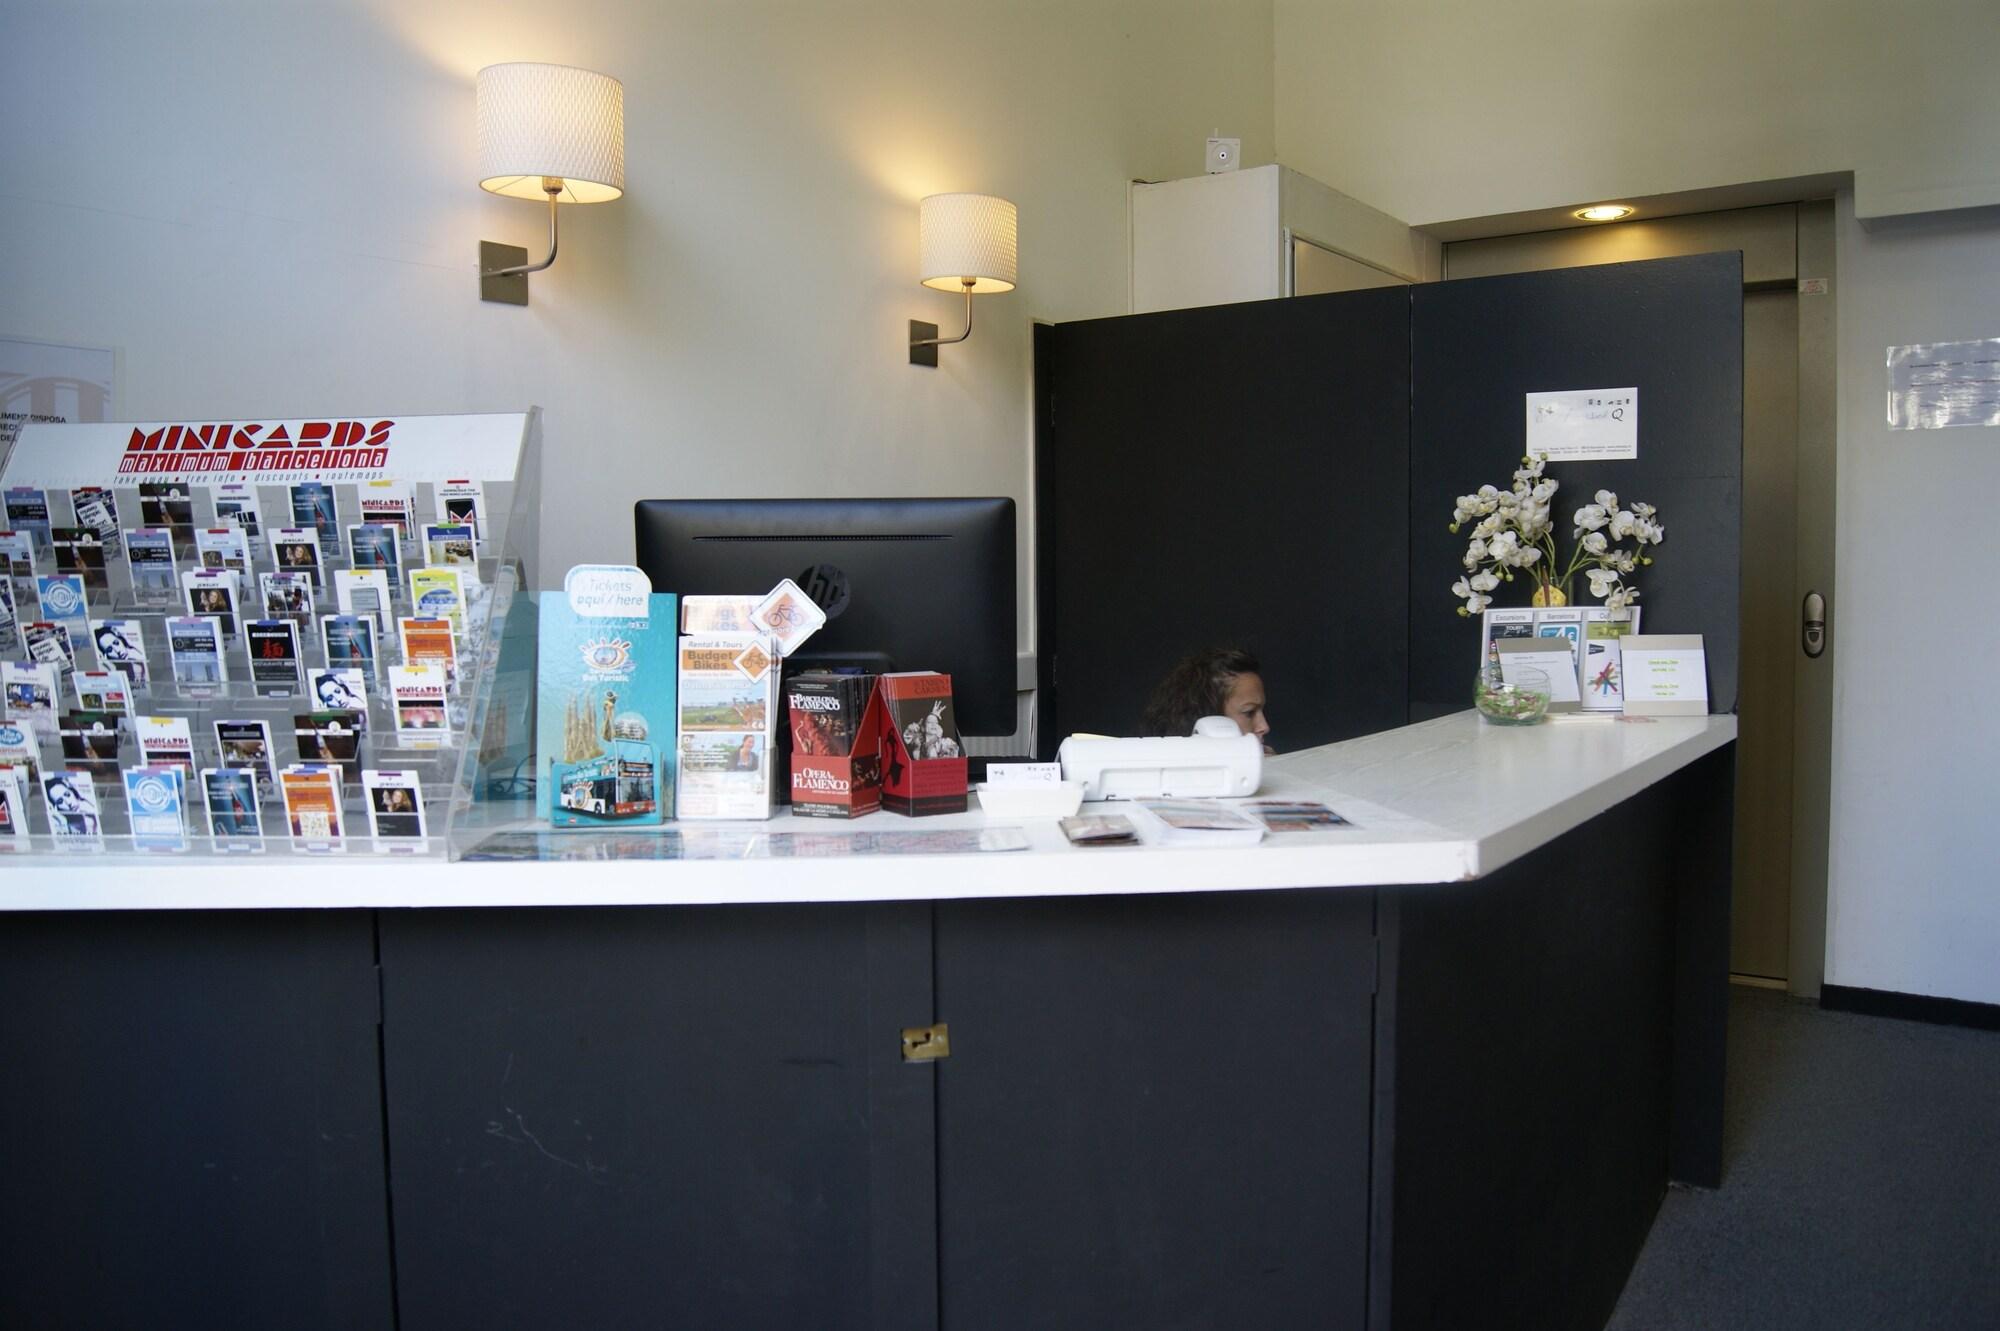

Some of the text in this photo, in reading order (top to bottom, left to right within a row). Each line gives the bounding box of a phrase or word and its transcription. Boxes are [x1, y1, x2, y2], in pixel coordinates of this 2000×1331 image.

[126, 420, 396, 451] MINICARDS
[120, 451, 385, 473] maximum barcelona
[185, 474, 208, 483] free
[213, 474, 236, 483] info
[254, 472, 309, 481] discounts
[326, 471, 384, 480] routemaps
[590, 579, 632, 592] Tickets
[615, 594, 644, 606] here
[688, 640, 713, 648] Rental
[688, 650, 733, 661] Budget
[693, 660, 728, 670] Bikes
[788, 694, 841, 711] FLAMENCO
[793, 773, 849, 790] FLAMENCO
